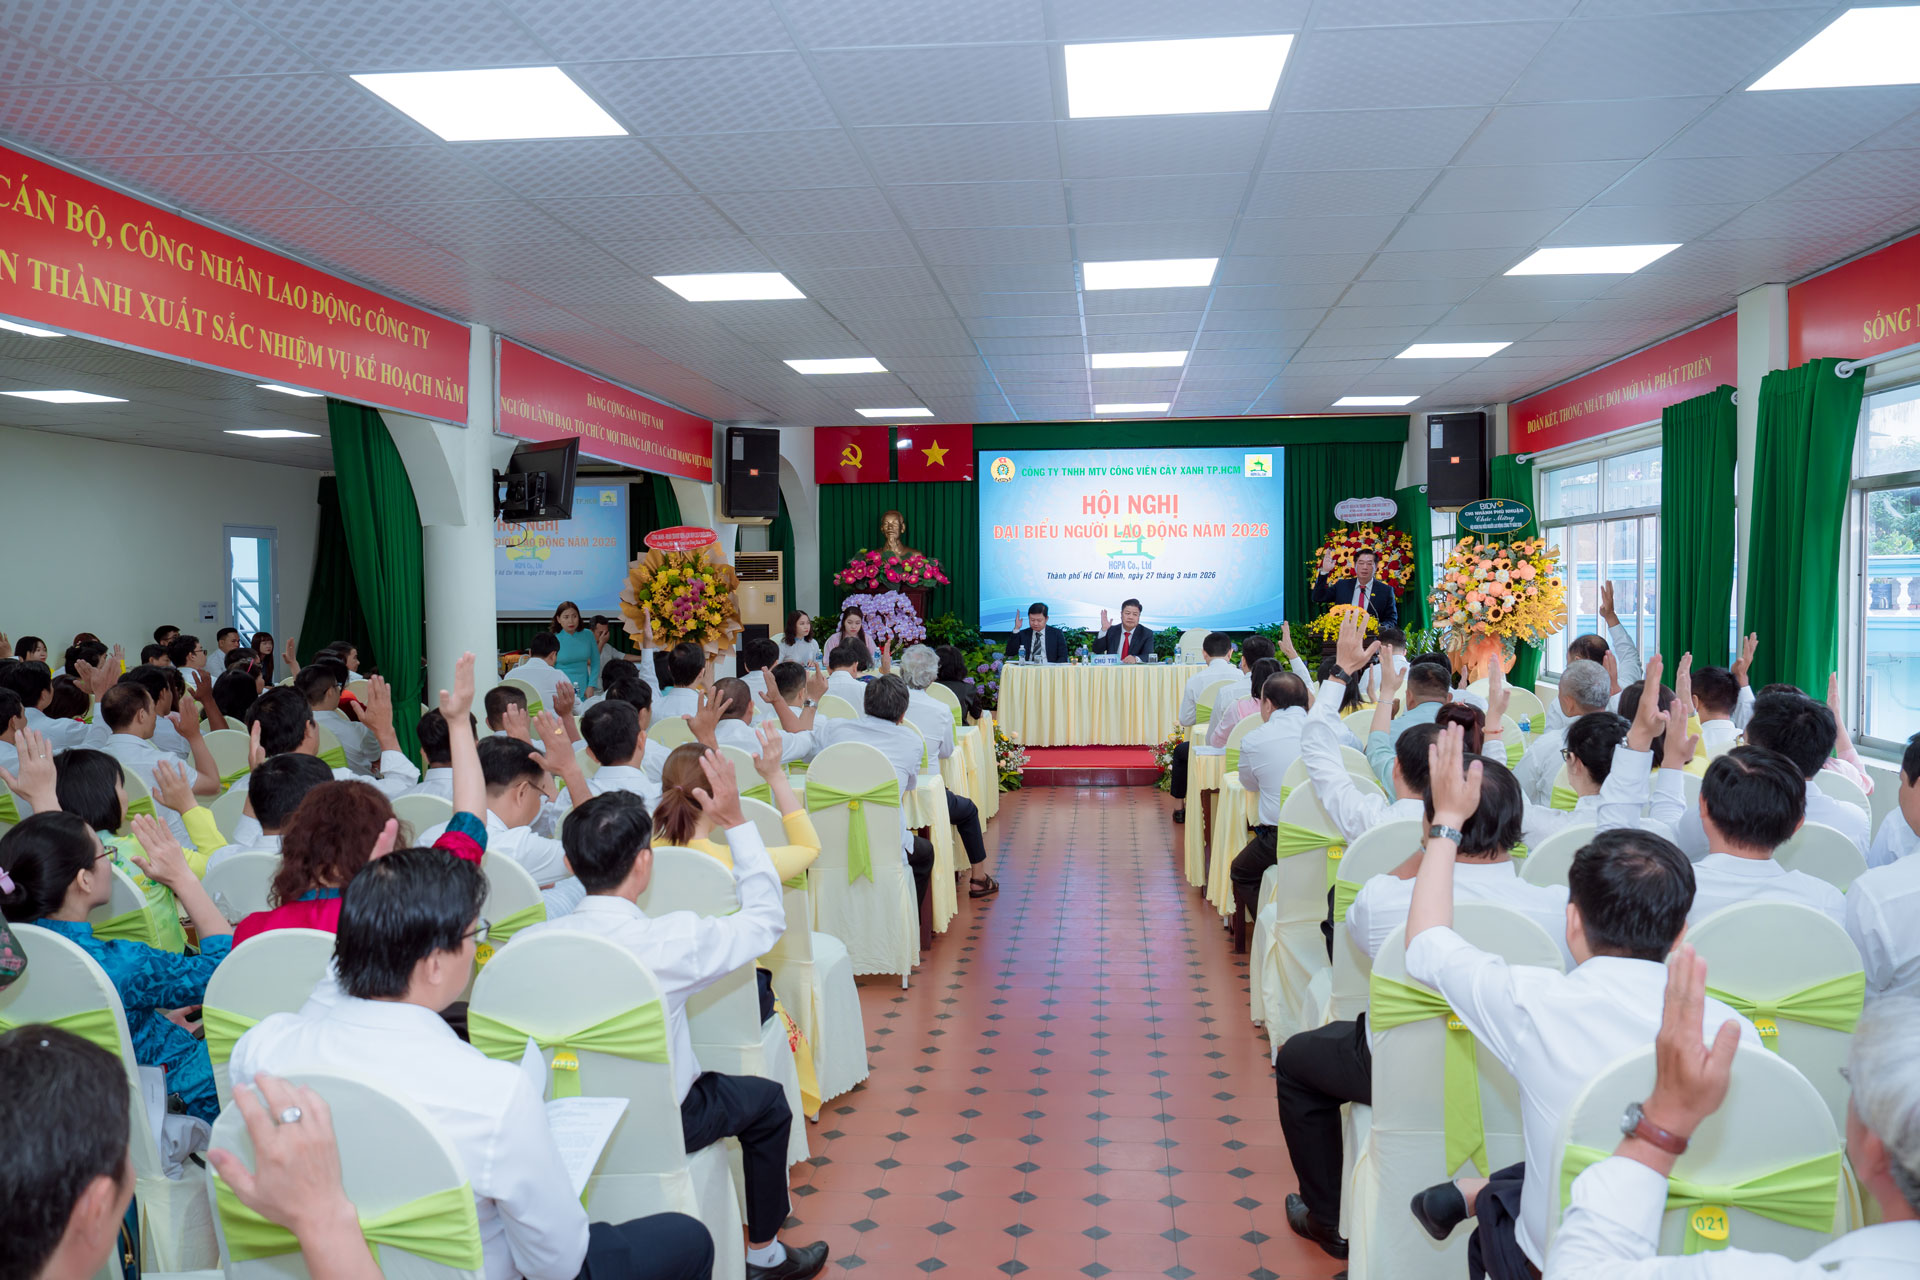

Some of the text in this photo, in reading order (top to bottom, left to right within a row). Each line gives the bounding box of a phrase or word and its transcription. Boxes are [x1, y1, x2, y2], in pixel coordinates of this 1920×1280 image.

[66, 199, 113, 249] BỘ,
[120, 221, 194, 271] CÔNG
[200, 254, 262, 294] NHÂN
[267, 275, 308, 310] LAO
[312, 291, 361, 326] ĐỘNG
[365, 308, 408, 343] CÔNG
[412, 324, 430, 350] TY
[27, 263, 132, 316] THÀNH
[139, 296, 207, 336] XUẤT
[212, 311, 254, 350] SẮC
[259, 330, 323, 369] NHIỆM
[327, 347, 351, 380] VỤ
[355, 353, 377, 382] KẾ
[380, 367, 432, 397] HOẠCH
[435, 378, 464, 404] NĂM
[1863, 308, 1911, 343] SỐNG
[1640, 374, 1653, 395] VÀ
[1654, 365, 1680, 391] PHÁT
[1681, 355, 1713, 383] TRIỂN
[500, 396, 530, 420] NGƯỜI
[651, 415, 664, 431] NAM
[1021, 465, 1045, 477] CÔNG
[1048, 467, 1059, 477] TY
[1062, 467, 1085, 476] TNHH
[1088, 467, 1107, 476] MTV
[1109, 464, 1134, 476] CÔNG
[1136, 464, 1157, 476] VIÊN
[1159, 464, 1177, 476] CÂY
[1180, 465, 1204, 475] XANH
[1207, 465, 1240, 475] TP.HCM
[1082, 489, 1178, 519] HỘI NGHỊ
[1479, 502, 1497, 510] BIDV
[993, 517, 1270, 542] ĐẠI BIỂU NGƯỜI LAO ĐỘNG NĂM 2026
[568, 536, 589, 548] NĂM
[592, 537, 617, 547] 2026
[1108, 560, 1126, 570] HGPA
[1141, 560, 1152, 570] Ltd
[1047, 571, 1067, 580] Thành
[1068, 571, 1082, 581] phố
[1083, 571, 1092, 580] Hồ
[1094, 571, 1105, 580] Chí
[1107, 571, 1125, 580] Minh,
[1128, 572, 1144, 581] ngày
[1146, 571, 1154, 579] 27
[1156, 571, 1175, 581] tháng
[1176, 571, 1182, 579] 3
[1200, 571, 1216, 579] 2026
[476, 949, 493, 960] 047
[1695, 1216, 1724, 1231] 021
